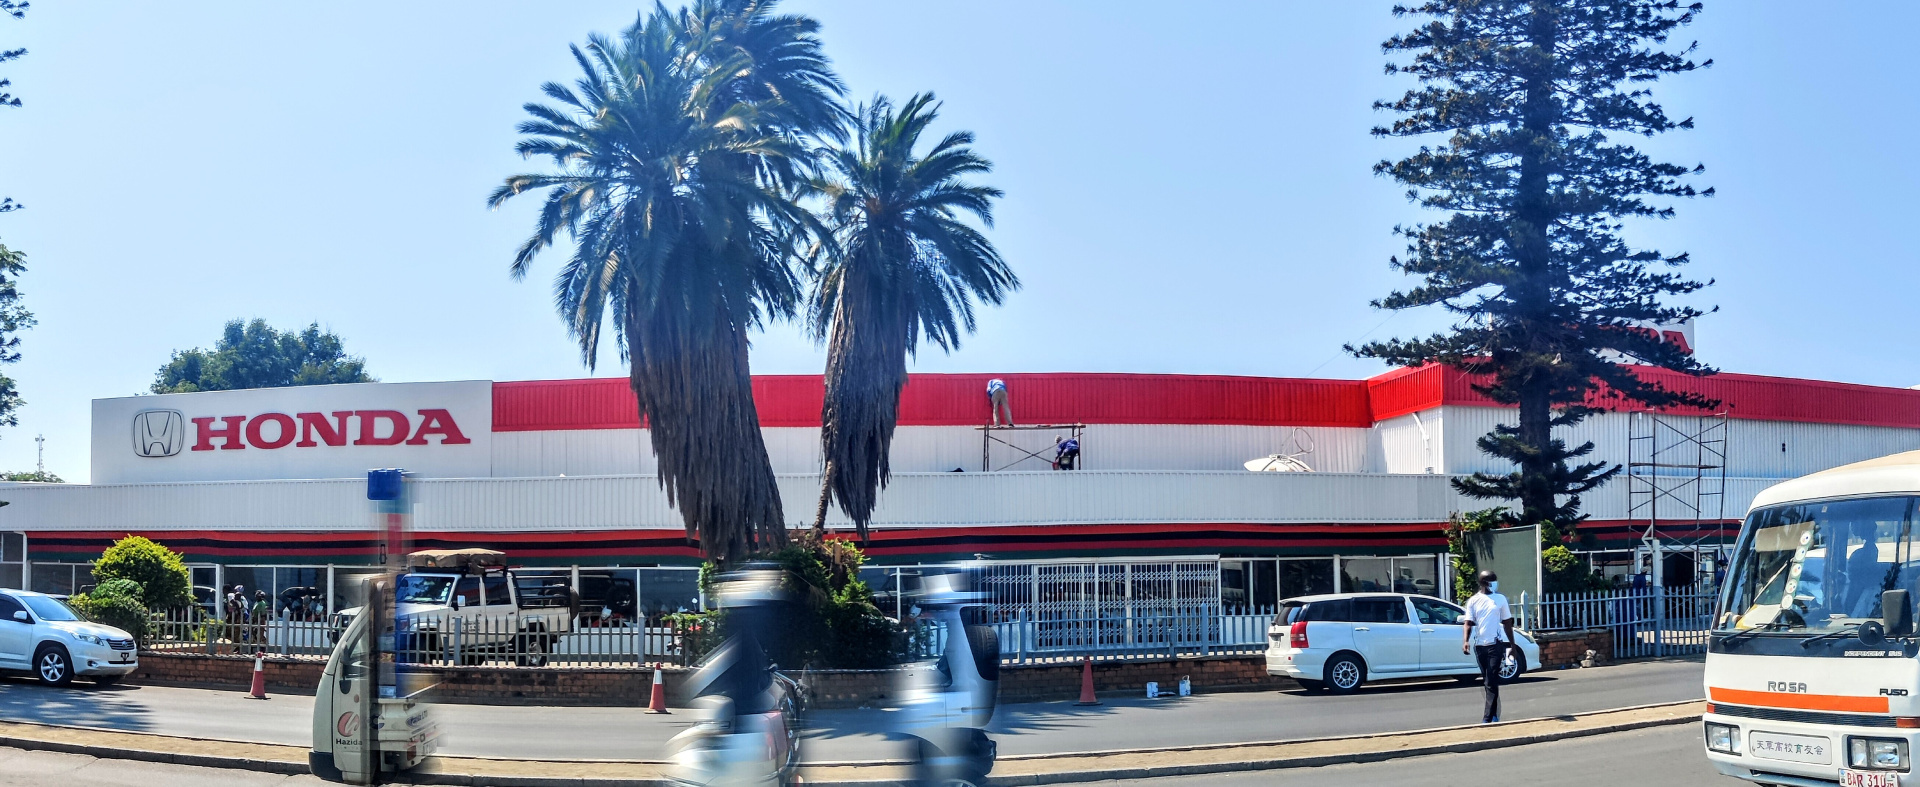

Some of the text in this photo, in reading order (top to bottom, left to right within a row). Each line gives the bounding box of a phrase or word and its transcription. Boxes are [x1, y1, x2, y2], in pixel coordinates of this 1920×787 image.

[191, 409, 471, 451] HONDA
[1767, 681, 1807, 693] ROSA
[1879, 688, 1909, 697] FUSO
[335, 738, 363, 746] Hazida
[1756, 740, 1824, 756] 天草高校育友会
[1847, 772, 1864, 787] BAR
